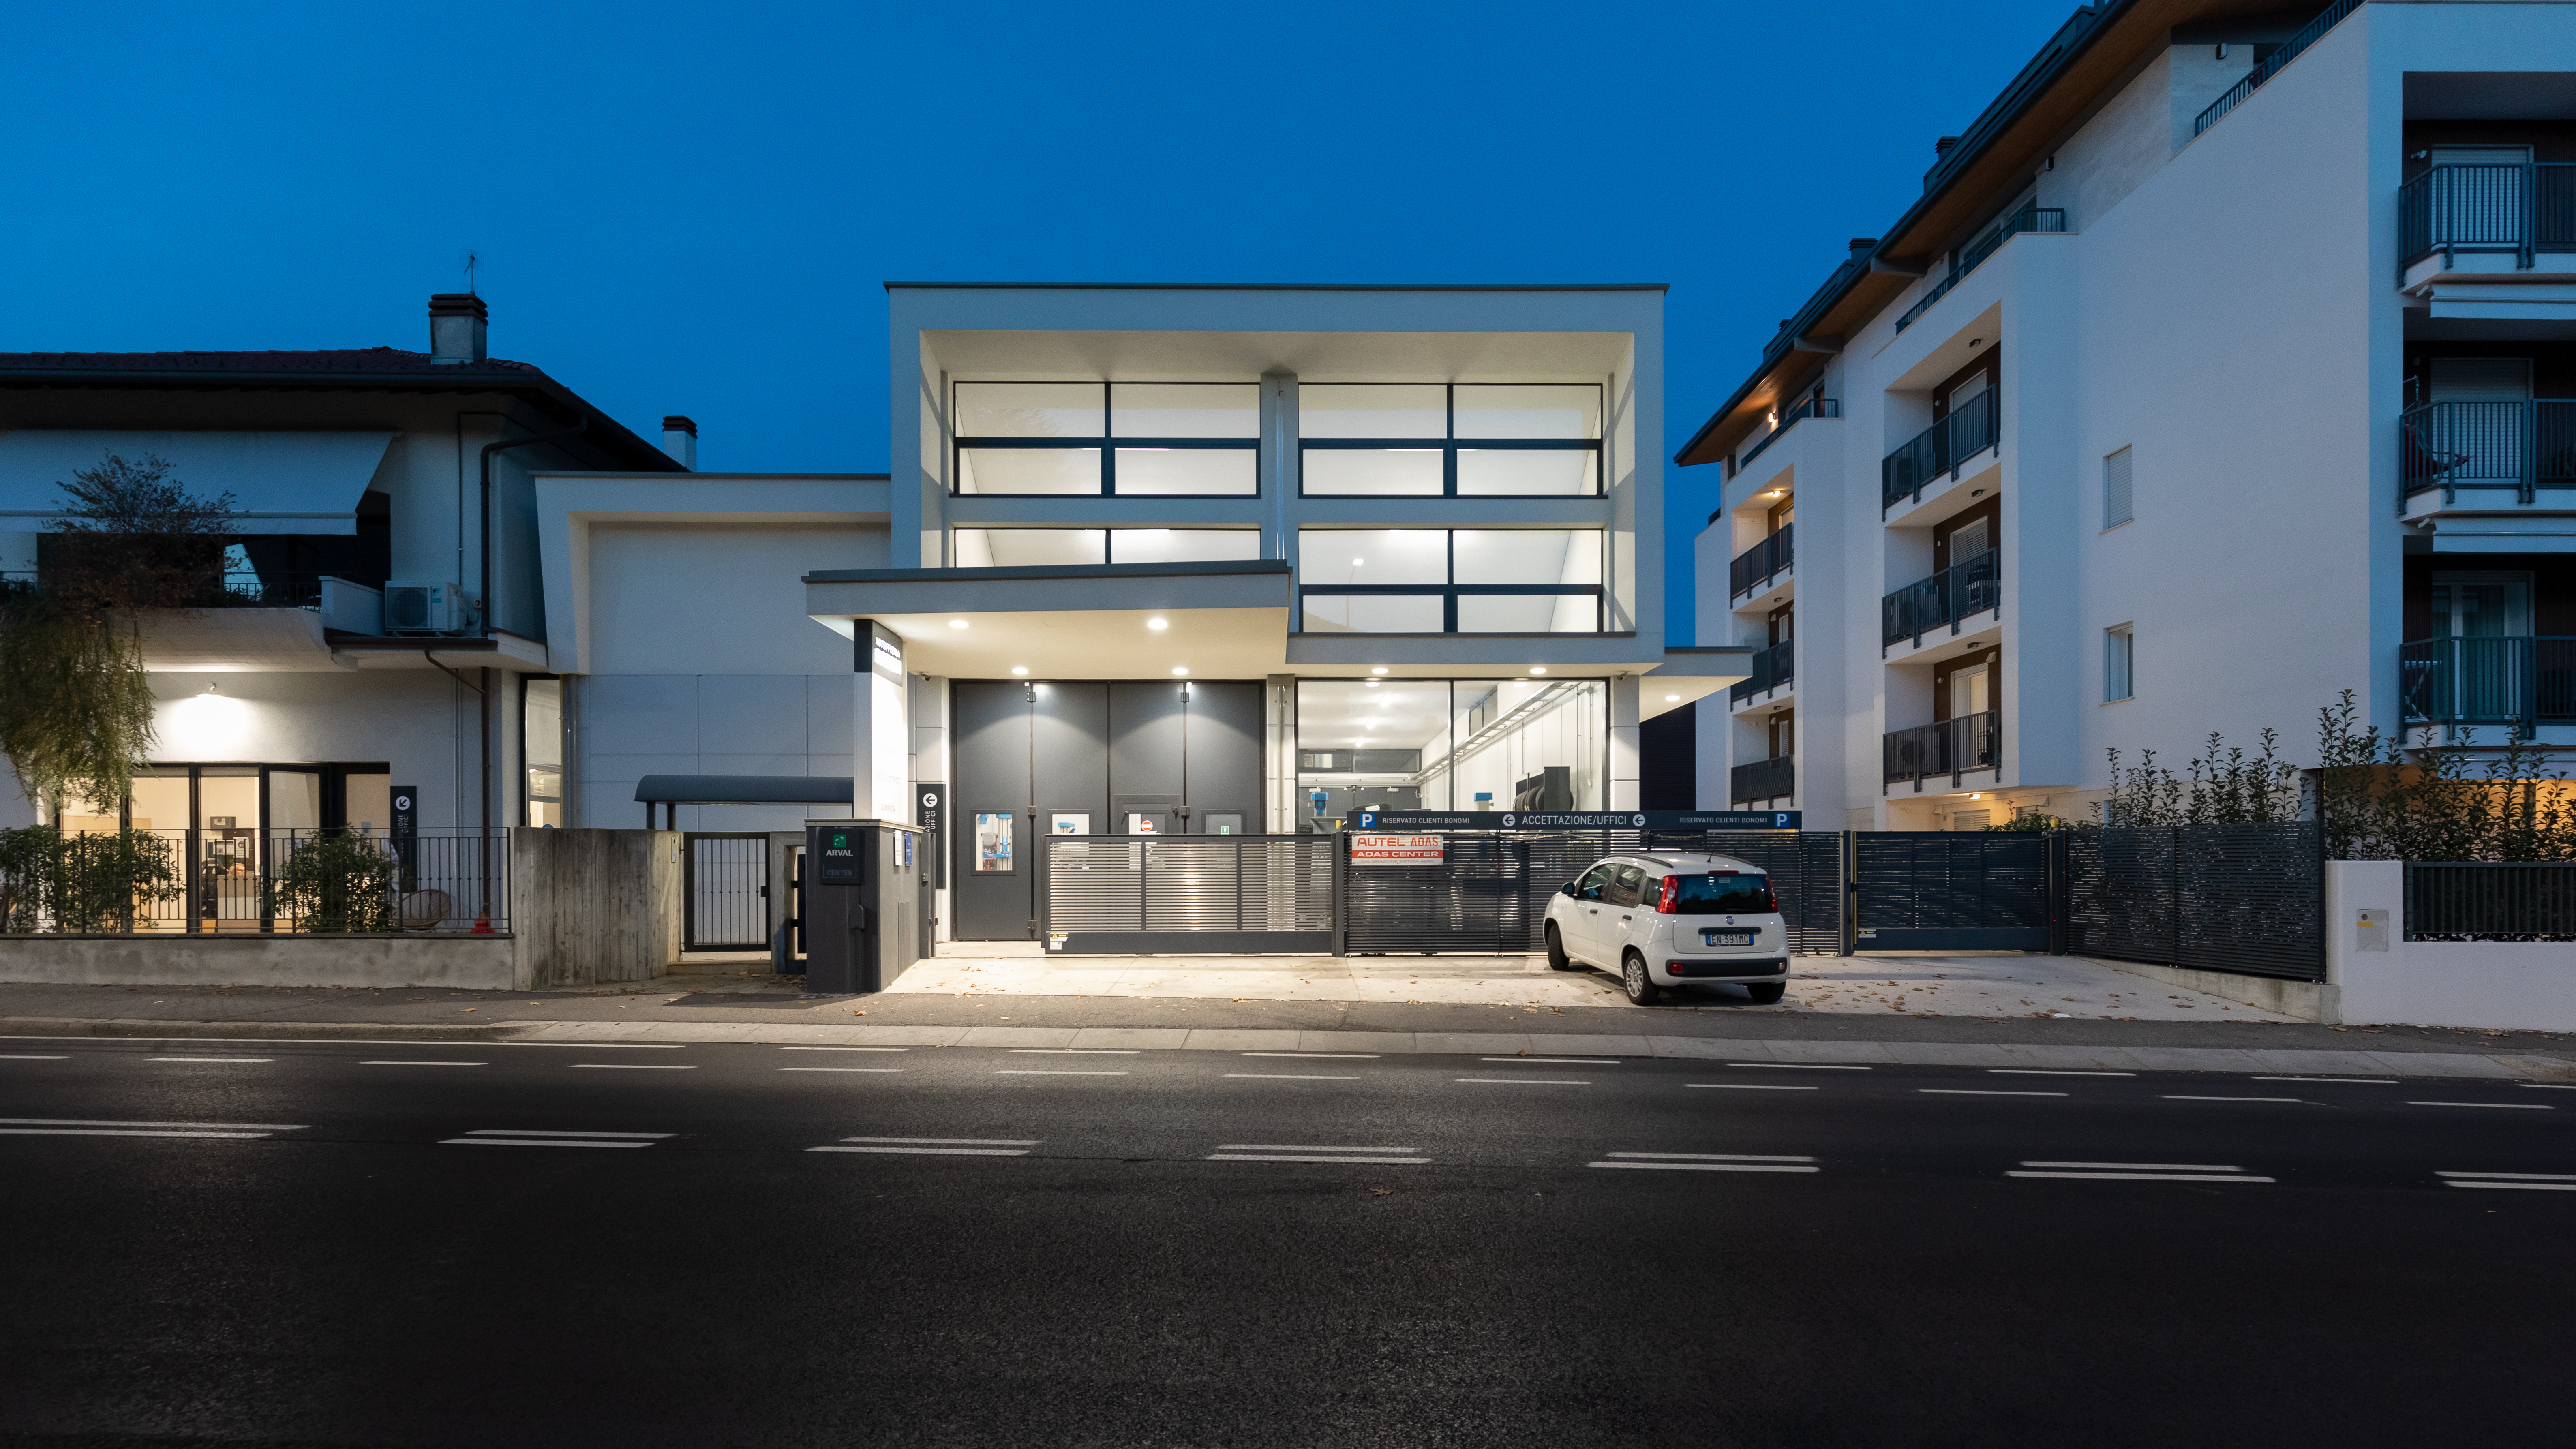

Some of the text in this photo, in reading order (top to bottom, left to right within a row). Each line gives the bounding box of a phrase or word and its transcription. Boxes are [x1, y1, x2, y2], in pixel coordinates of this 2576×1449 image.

[1362, 814, 1373, 827] P
[1522, 815, 1627, 825] ACCETTAZIONE/UFFICI
[1777, 813, 1787, 826] P
[1357, 837, 1439, 846] AUTEL ADAS
